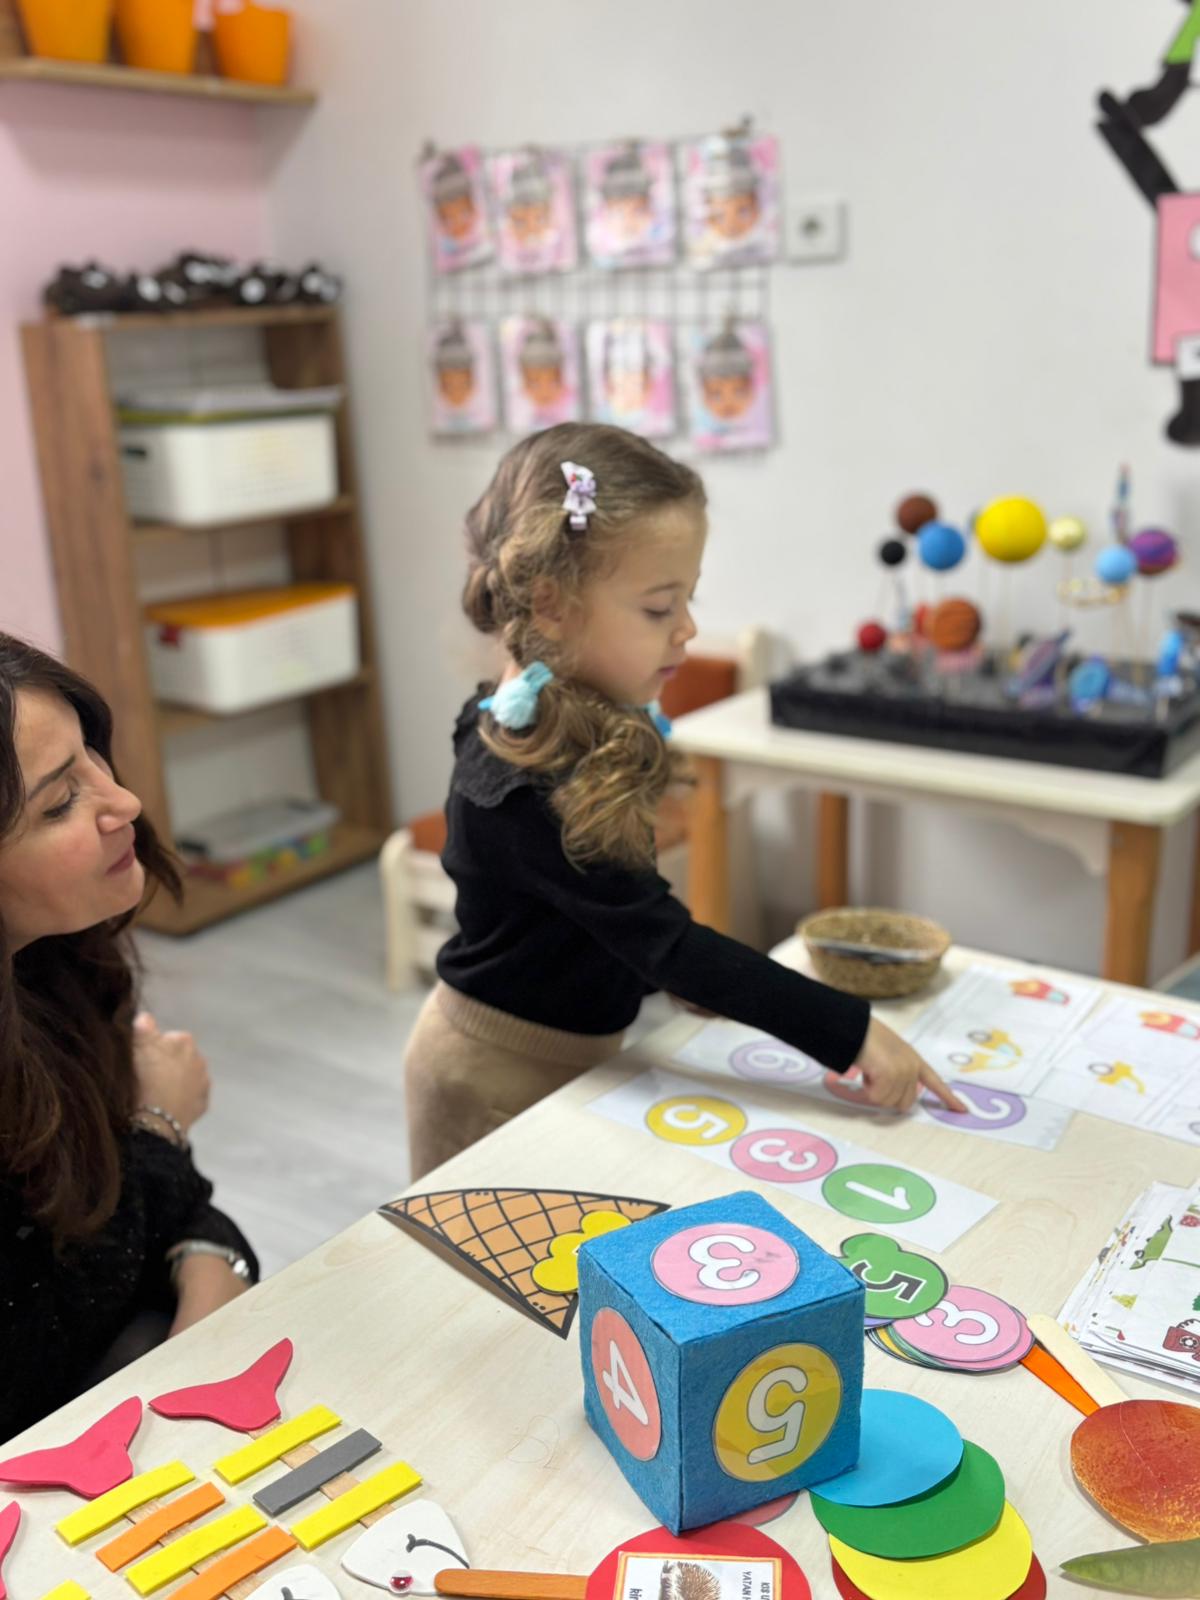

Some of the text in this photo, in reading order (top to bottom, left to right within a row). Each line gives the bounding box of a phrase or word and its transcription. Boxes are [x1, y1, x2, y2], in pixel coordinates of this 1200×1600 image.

[746, 1050, 807, 1075] 6
[662, 1103, 731, 1139] 5
[748, 1137, 819, 1172] 3
[845, 1180, 912, 1211] 1
[688, 1233, 761, 1290] 3
[850, 1259, 927, 1304] 5
[913, 1299, 1000, 1345] 3
[602, 1340, 649, 1425] 4
[746, 1365, 808, 1465] 5
